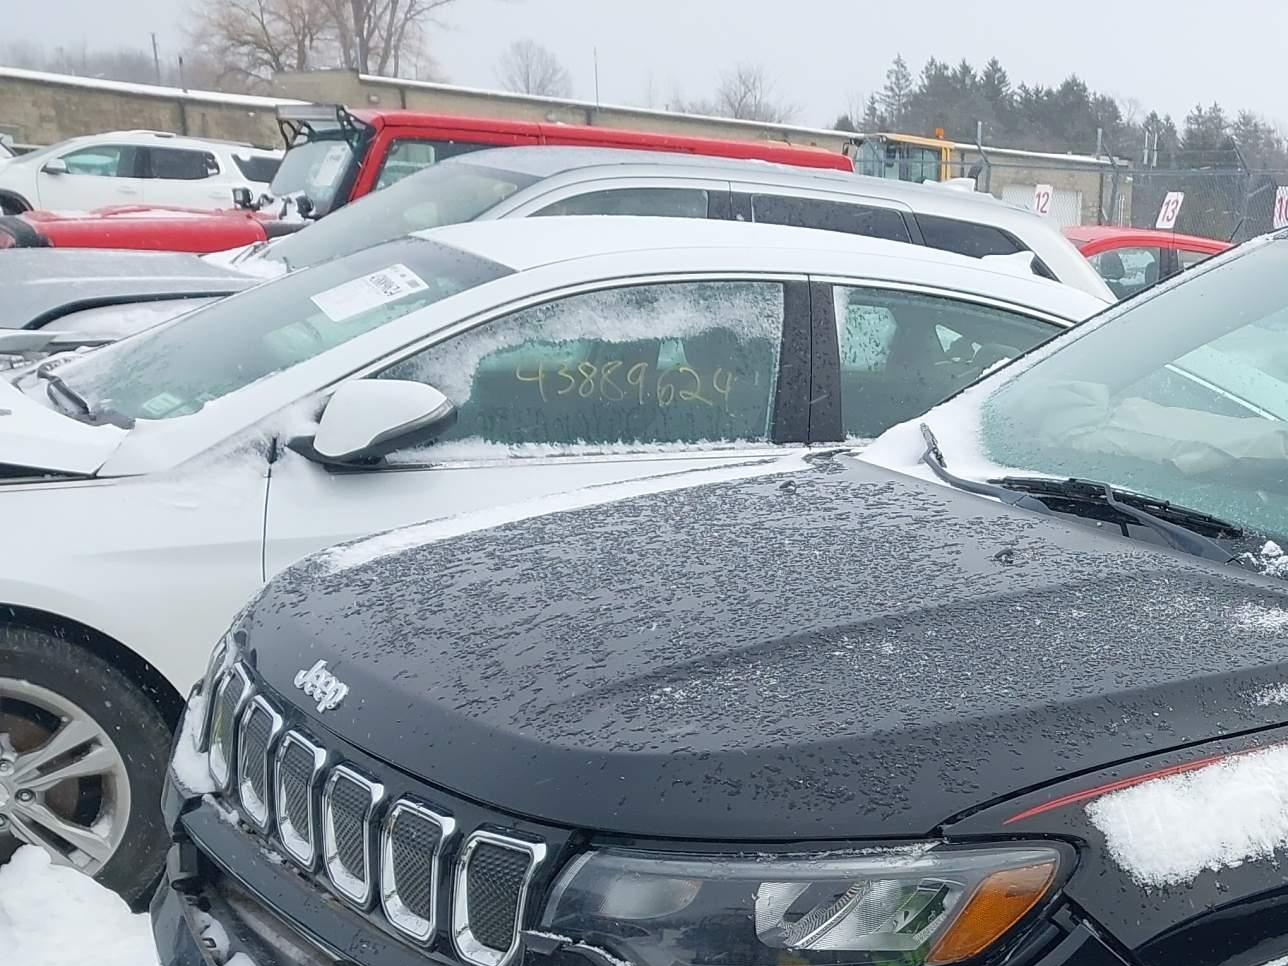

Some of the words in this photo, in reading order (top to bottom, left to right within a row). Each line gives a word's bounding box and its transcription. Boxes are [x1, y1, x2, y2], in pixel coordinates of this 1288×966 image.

[1034, 191, 1050, 214] 12
[1160, 199, 1179, 223] 13
[515, 360, 737, 417] 43889624
[294, 659, 349, 713] Jeep
